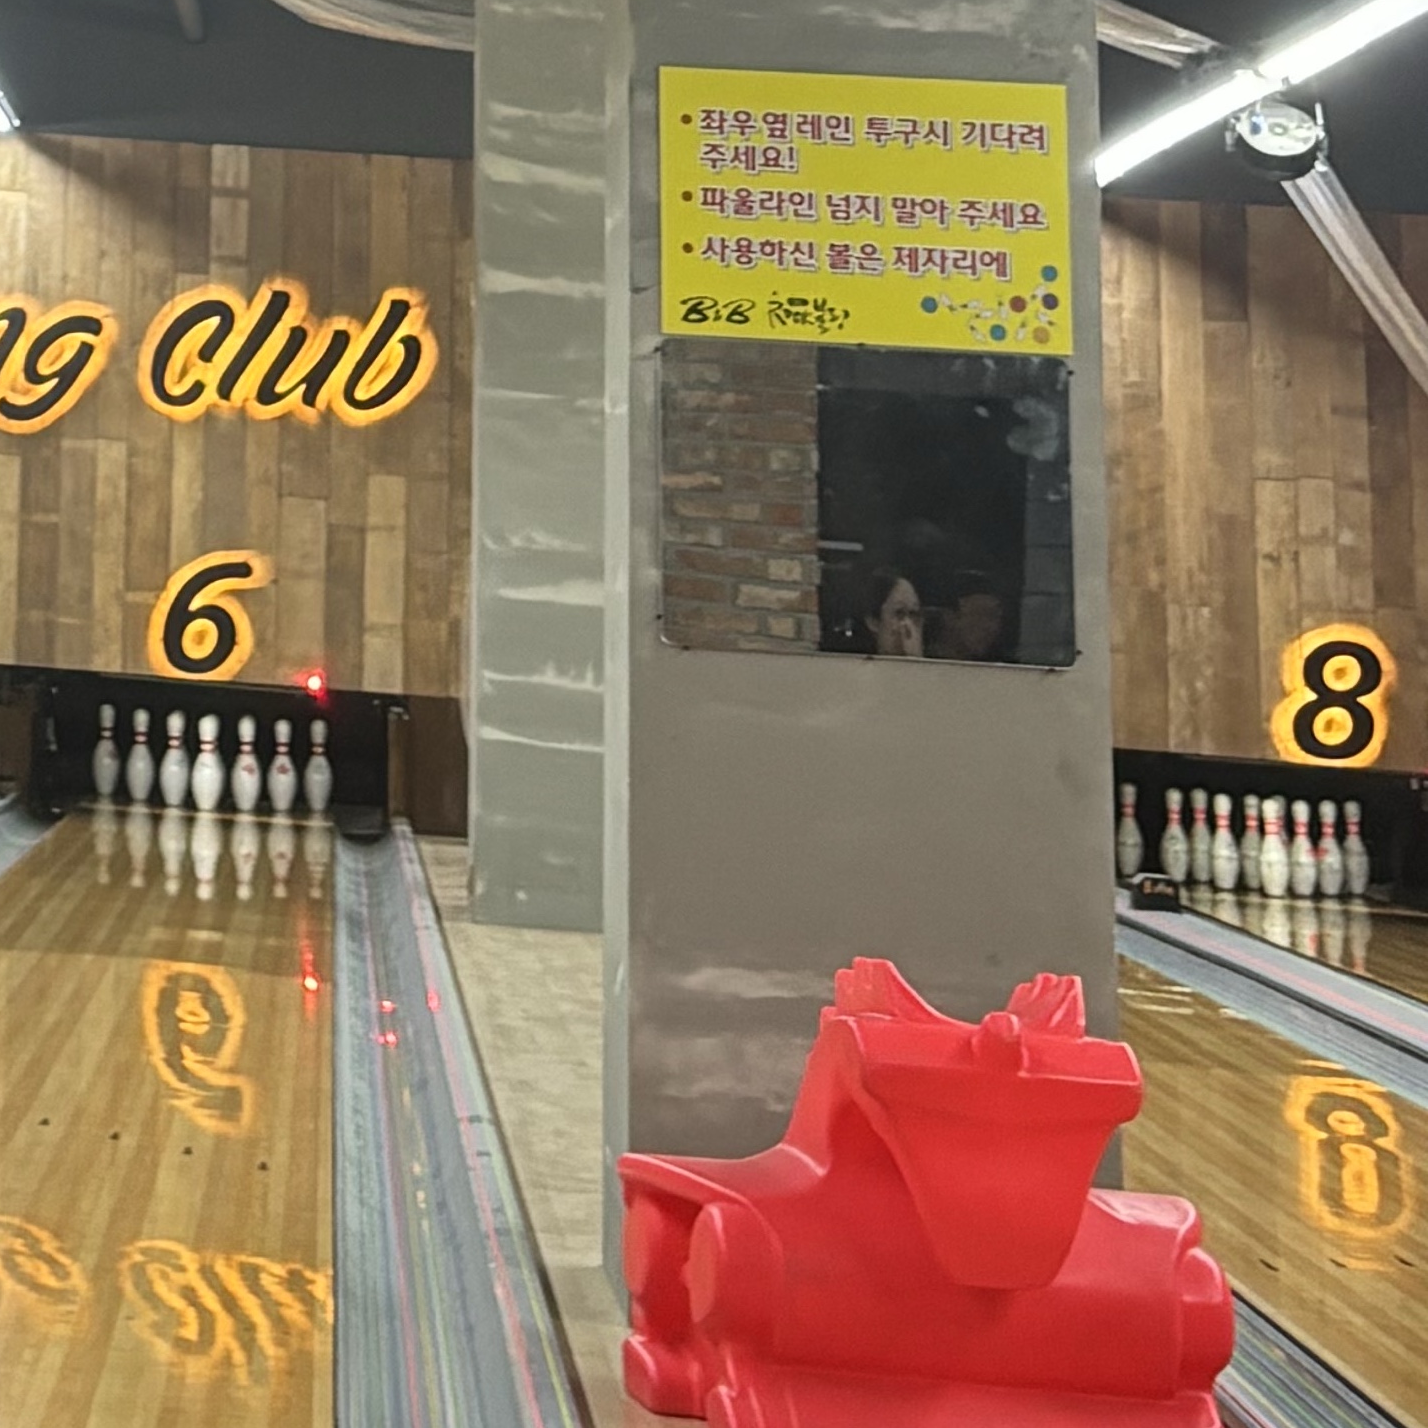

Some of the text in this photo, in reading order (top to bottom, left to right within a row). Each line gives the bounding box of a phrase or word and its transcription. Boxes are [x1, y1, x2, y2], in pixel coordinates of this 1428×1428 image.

[864, 116, 950, 147] 투구시
[960, 120, 1046, 152] 기다려
[699, 142, 797, 172] 주세요!
[699, 186, 1047, 229] 파울라인 넘지 말아 주세요
[700, 235, 1010, 279] 사용하신 볼은 제자리에
[148, 287, 421, 414] Club
[162, 559, 253, 673] 6
[1292, 640, 1383, 760] 8
